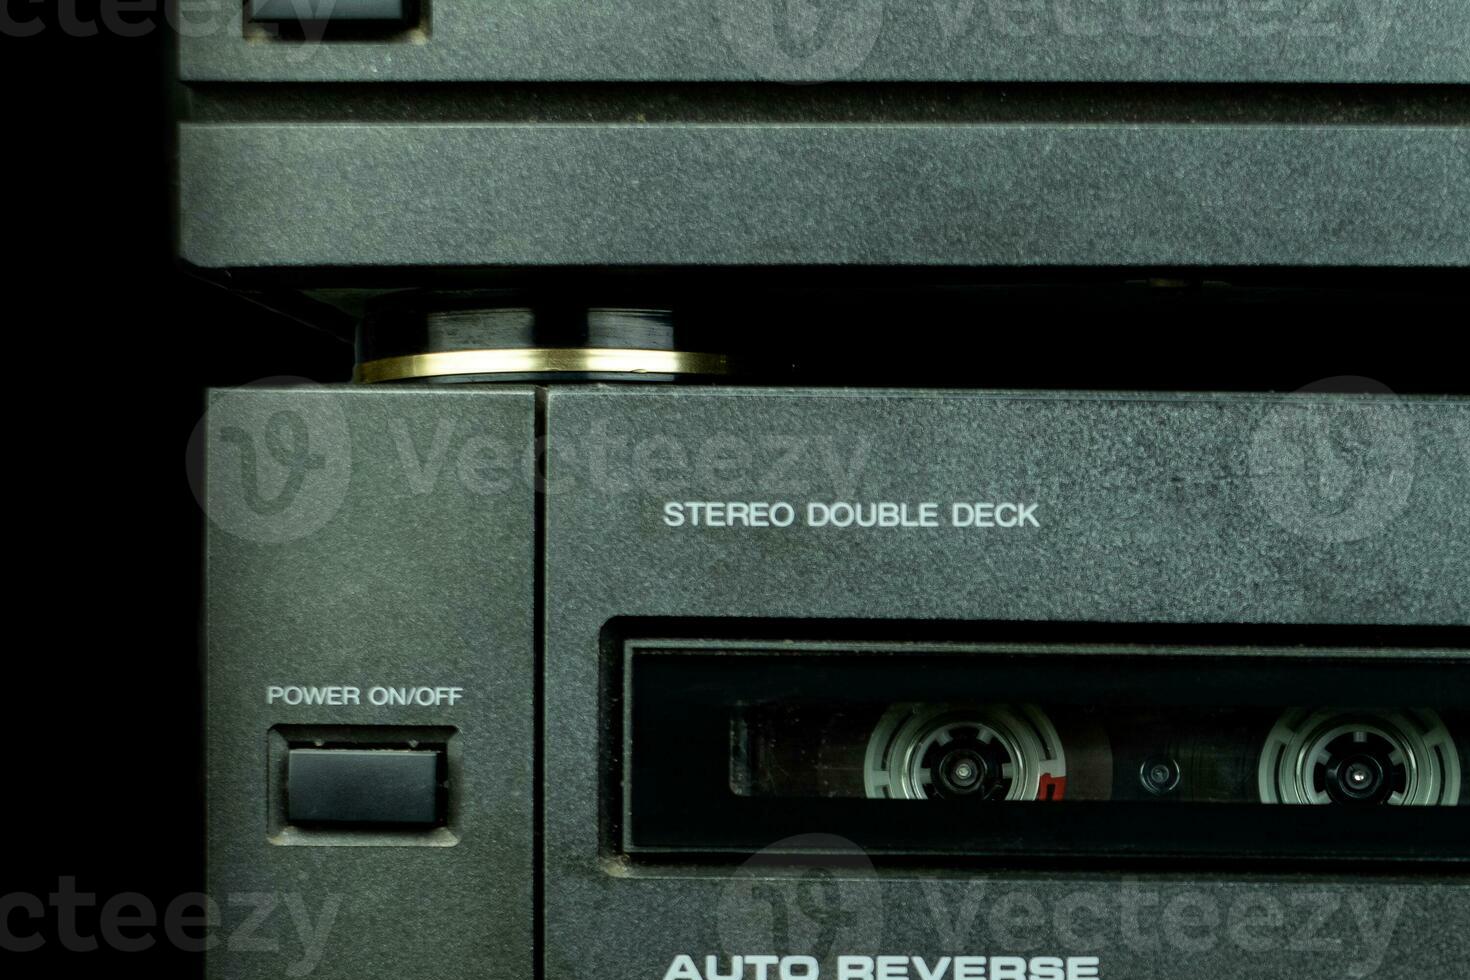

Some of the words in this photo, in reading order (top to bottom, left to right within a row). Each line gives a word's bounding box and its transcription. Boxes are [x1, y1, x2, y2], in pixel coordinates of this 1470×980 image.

[664, 501, 793, 528] STEREO
[807, 501, 938, 528] DOUBLE
[952, 501, 1039, 528] DECK
[267, 687, 360, 705] POWER
[369, 687, 463, 705] ON/OFF
